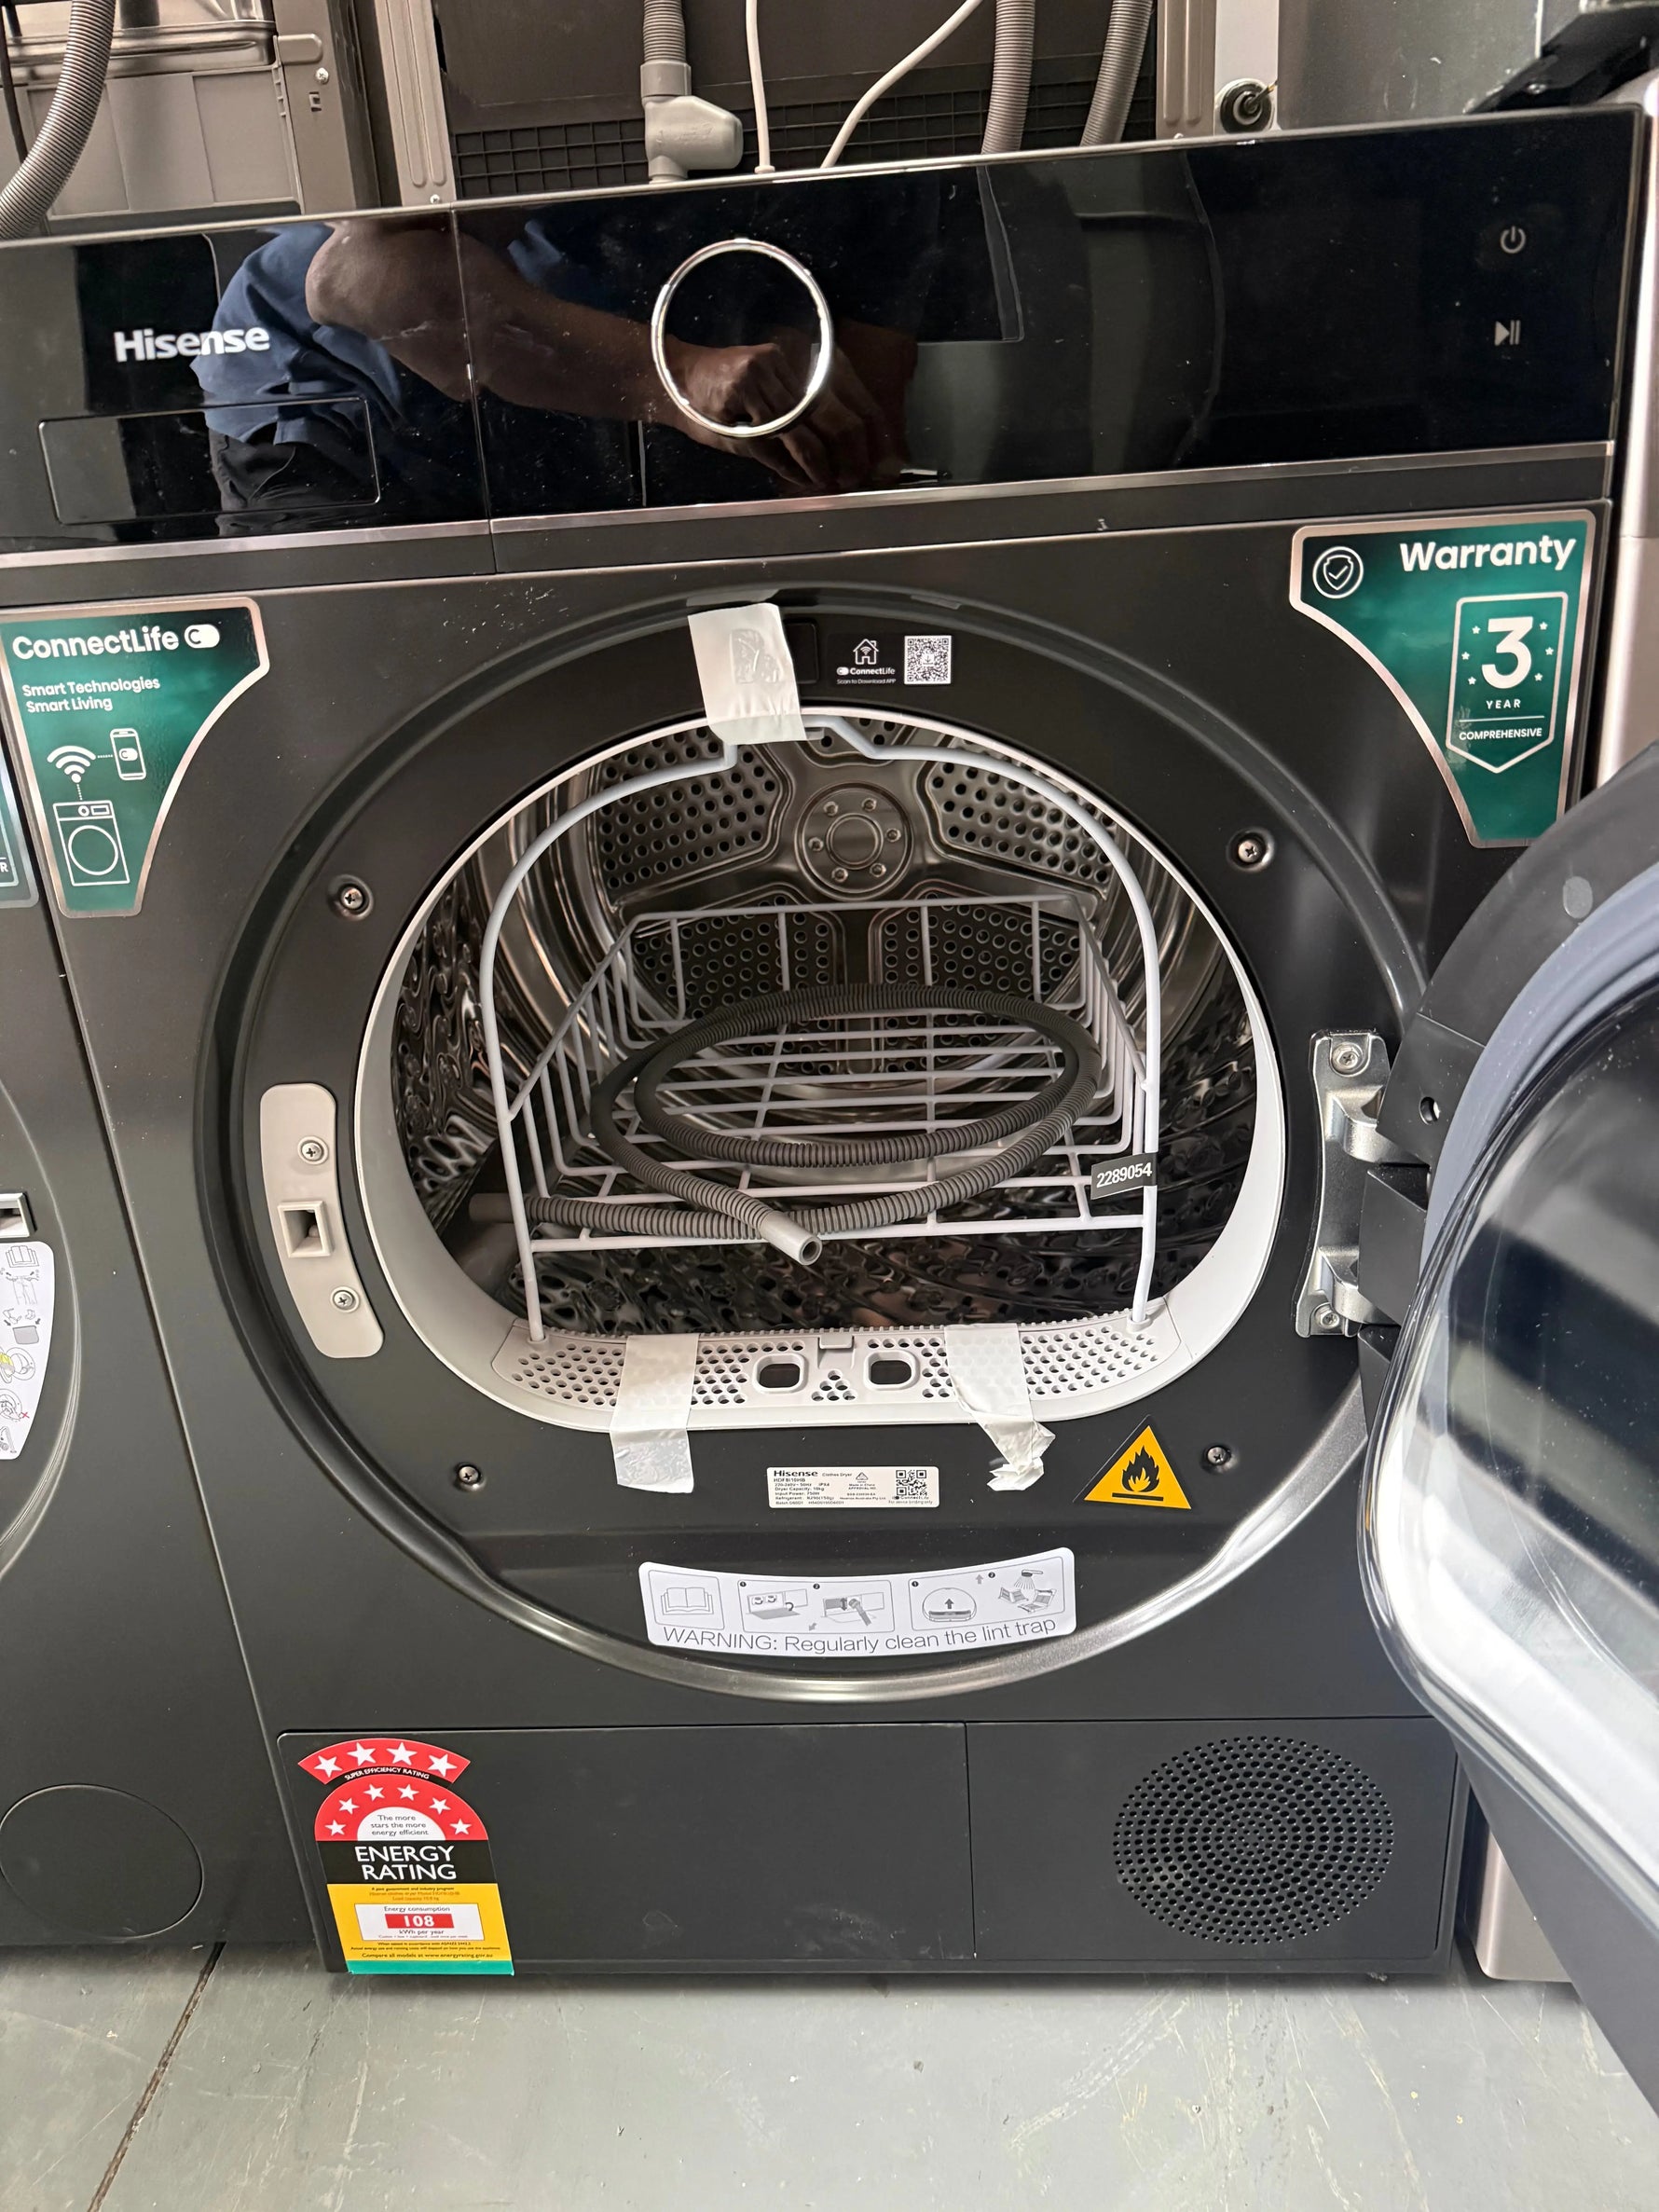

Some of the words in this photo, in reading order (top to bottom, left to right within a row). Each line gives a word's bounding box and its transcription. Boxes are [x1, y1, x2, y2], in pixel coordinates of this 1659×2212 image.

[114, 327, 270, 362] Hisense
[1400, 534, 1577, 571] Warranty
[12, 625, 180, 660] ConnectLife
[1481, 616, 1534, 689] 3
[850, 666, 896, 675] ConnectLife
[22, 680, 66, 697] Smart
[67, 677, 161, 695] Technologies
[26, 697, 71, 713] Smart
[73, 697, 113, 712] Living
[1486, 699, 1521, 709] YEAR
[1459, 727, 1542, 740] COMPREHENSIVE
[1096, 1162, 1153, 1188] 2289054
[663, 1627, 777, 1650] WARNING:
[785, 1635, 879, 1654] Regularly
[885, 1635, 939, 1650] clean
[945, 1630, 977, 1645] the
[982, 1624, 1011, 1642] lint
[1015, 1619, 1056, 1635] trap
[344, 1770, 363, 1780] SUPER
[363, 1766, 402, 1775] EFFICIENCY
[403, 1768, 430, 1779] RATING
[354, 1845, 455, 1863] ENERGY
[362, 1863, 457, 1881] RATING
[404, 1915, 435, 1927] 108
